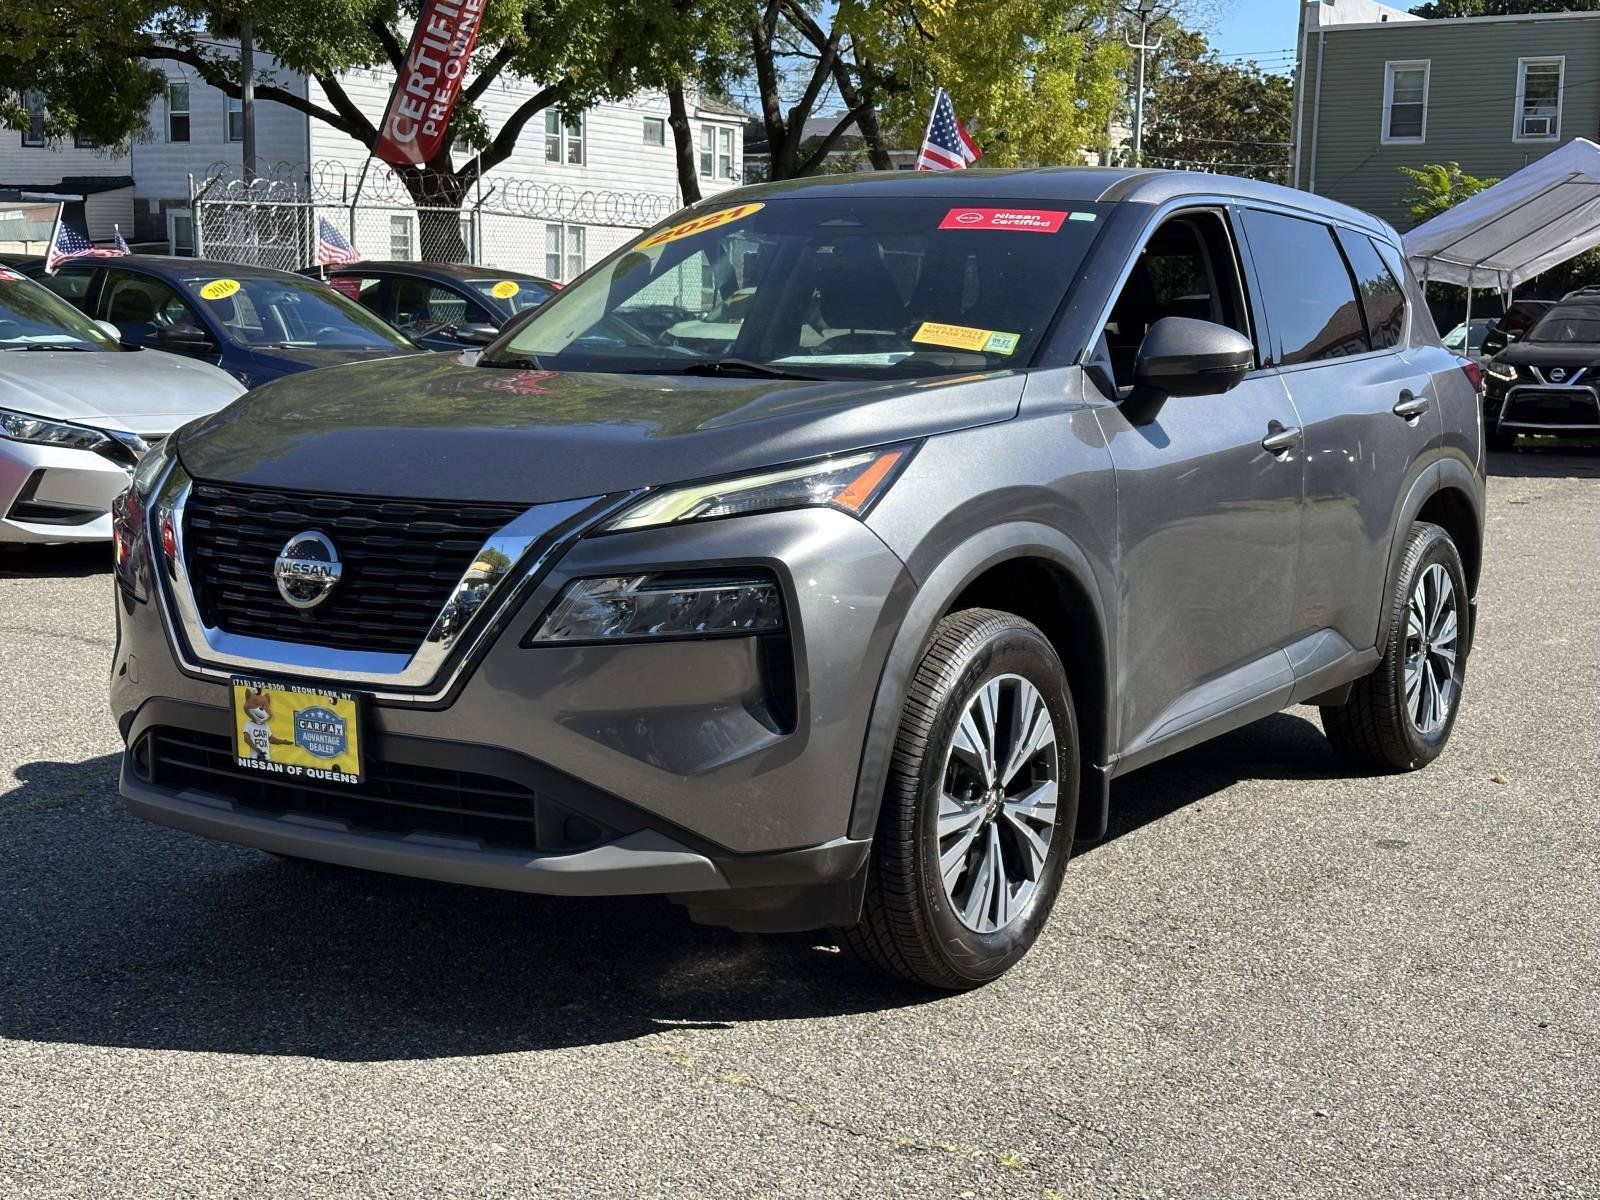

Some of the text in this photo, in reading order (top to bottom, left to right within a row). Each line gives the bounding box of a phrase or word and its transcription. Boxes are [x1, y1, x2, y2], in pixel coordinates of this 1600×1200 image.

[391, 0, 465, 143] CERTIFI
[646, 206, 747, 248] 2021
[991, 218, 1051, 227] Certified
[207, 281, 235, 297] 2016
[280, 561, 333, 576] NISSAN
[291, 685, 316, 695] OZONE
[341, 692, 352, 700] NY
[253, 729, 267, 738] CAR
[299, 720, 344, 735] CARFAX
[254, 738, 268, 748] FOX
[302, 732, 340, 746] ADVANTAGE
[309, 742, 334, 754] DEALER
[238, 758, 358, 784] NISSAN OF QUEENS
